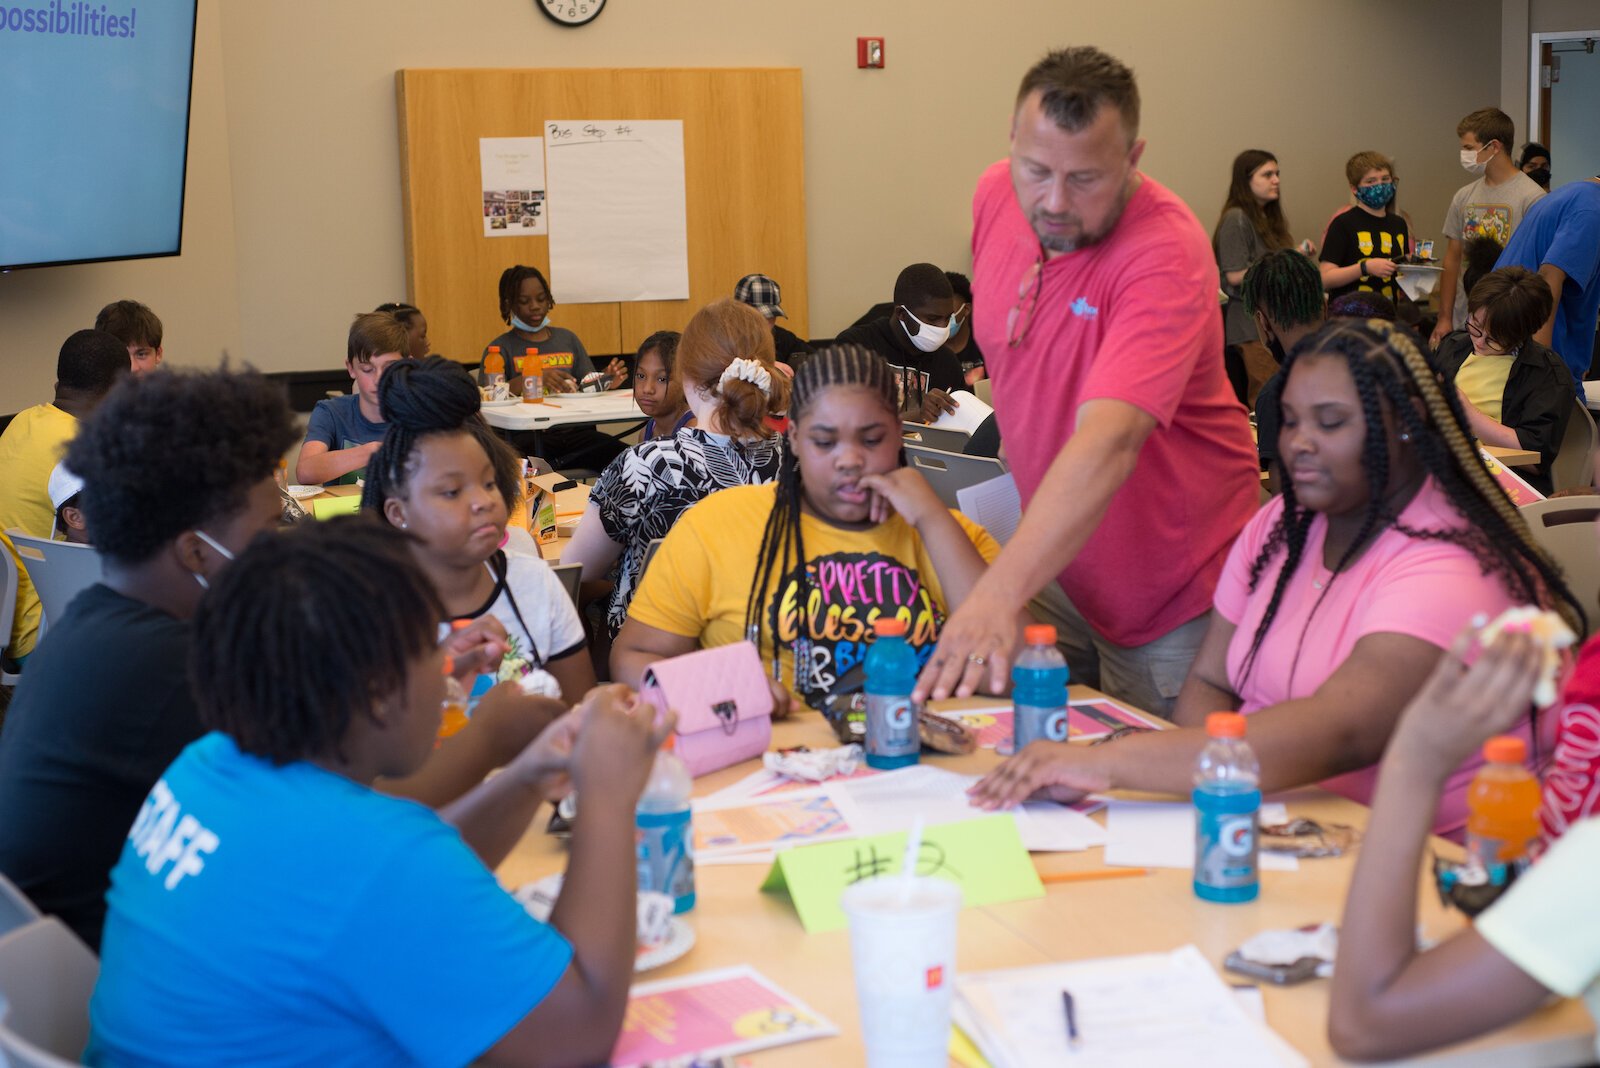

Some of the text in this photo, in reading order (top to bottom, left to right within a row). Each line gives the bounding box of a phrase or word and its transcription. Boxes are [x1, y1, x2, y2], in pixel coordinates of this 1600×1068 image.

[0, 0, 136, 38] possibilities!
[568, 8, 576, 17] 6
[580, 4, 587, 14] 5
[548, 124, 573, 139] Bus
[524, 377, 534, 390] G
[819, 560, 921, 607] PRETTY
[885, 701, 911, 730] G
[1045, 709, 1069, 742] G
[1220, 817, 1253, 857] G
